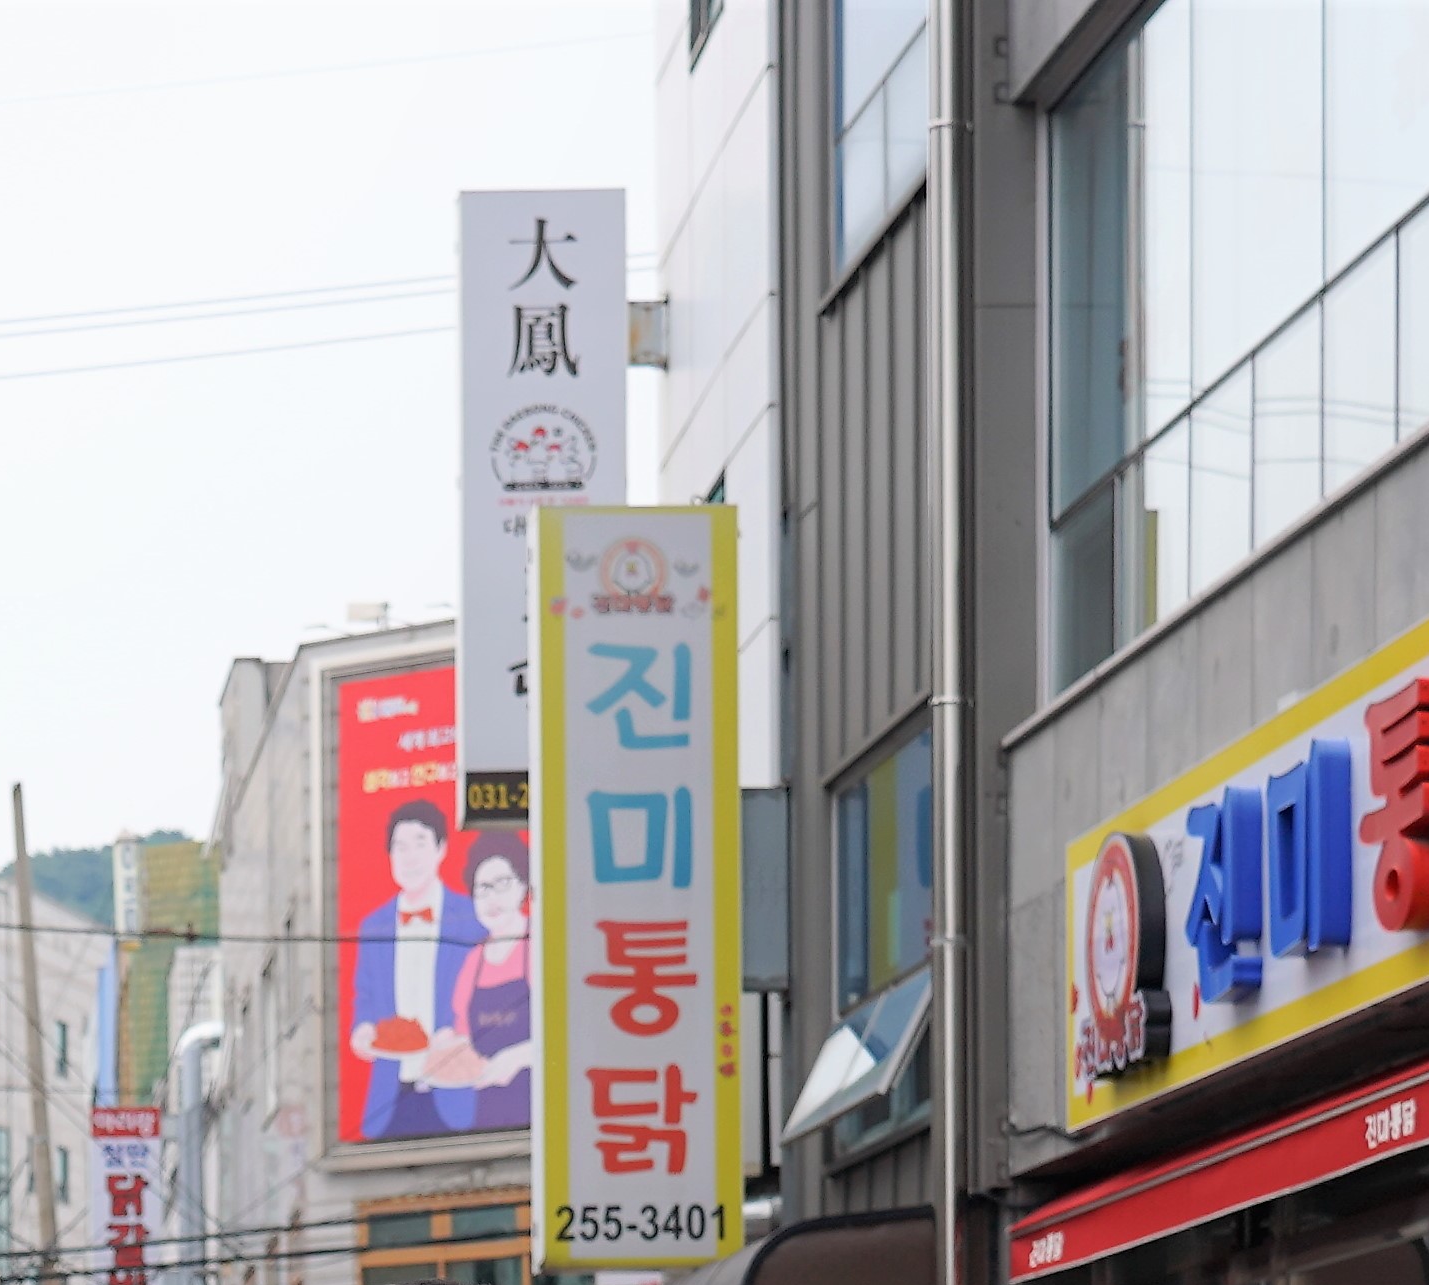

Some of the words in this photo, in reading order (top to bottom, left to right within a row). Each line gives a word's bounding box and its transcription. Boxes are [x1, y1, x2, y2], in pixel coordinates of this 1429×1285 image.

[508, 216, 581, 379] 大鳳
[586, 641, 699, 1176] 진미통닭
[1363, 1096, 1417, 1150] 진미통닭
[555, 1203, 728, 1245] 255-3401
